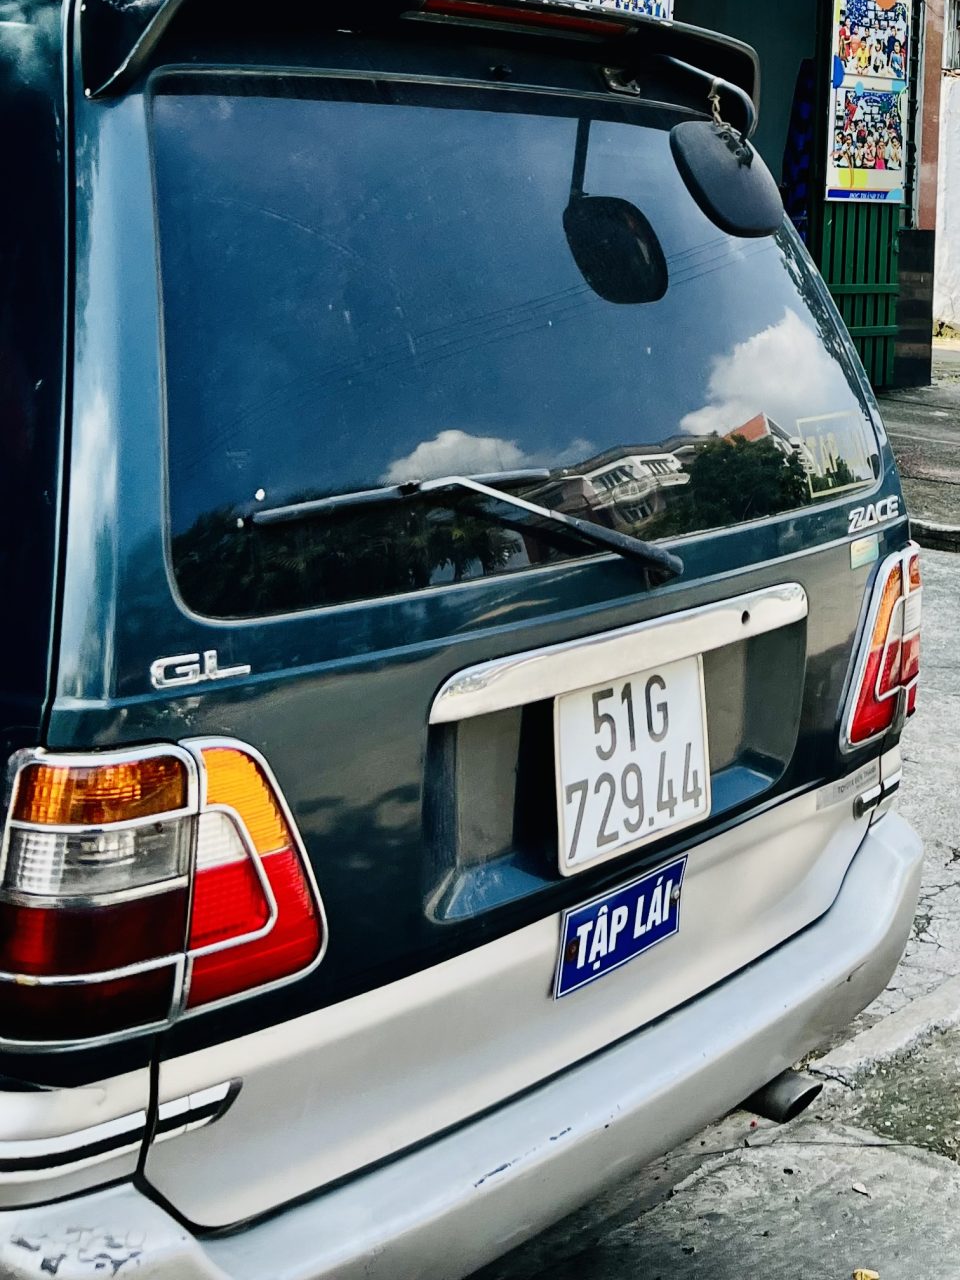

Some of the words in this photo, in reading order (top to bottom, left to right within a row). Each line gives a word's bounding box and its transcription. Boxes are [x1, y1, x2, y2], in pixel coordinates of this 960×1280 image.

[848, 495, 899, 533] ZACE
[150, 650, 251, 689] GL
[591, 674, 670, 761] 51G
[565, 742, 703, 860] 729.44
[576, 902, 629, 971] TẬP
[632, 871, 674, 941] LÁI
